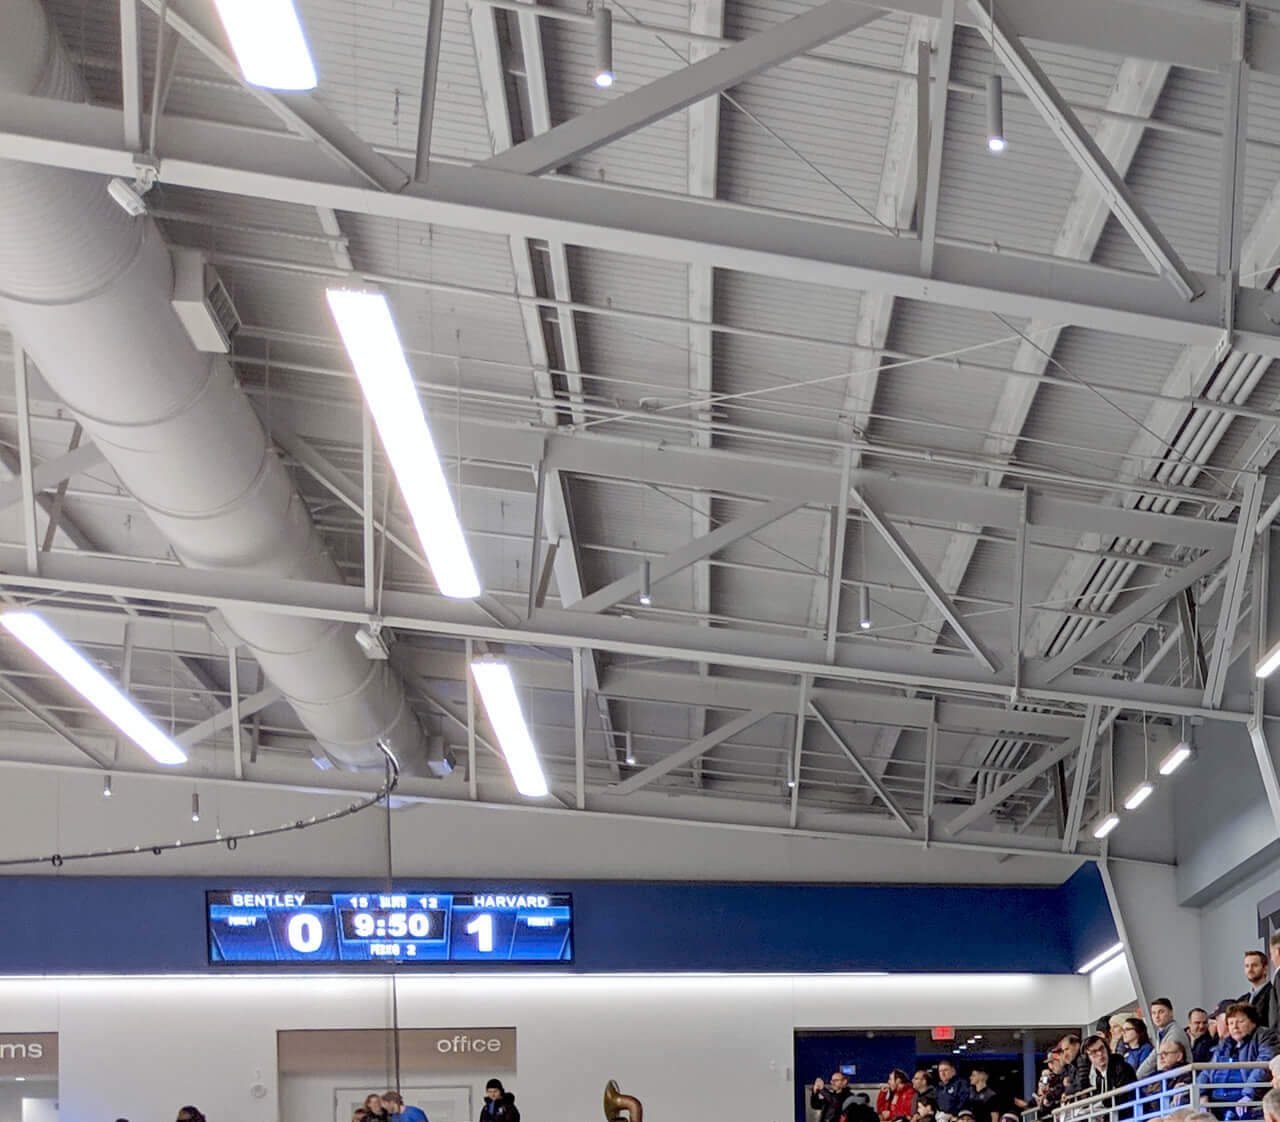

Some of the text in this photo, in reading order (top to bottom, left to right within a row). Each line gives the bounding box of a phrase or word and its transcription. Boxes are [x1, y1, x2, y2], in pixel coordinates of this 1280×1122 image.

[232, 893, 306, 907] BENTLEY
[474, 895, 549, 908] HARVARD
[353, 912, 430, 936] 9:50
[288, 913, 323, 953] 0
[467, 914, 493, 953] 1
[0, 1042, 43, 1059] ms
[437, 1037, 502, 1053] office
